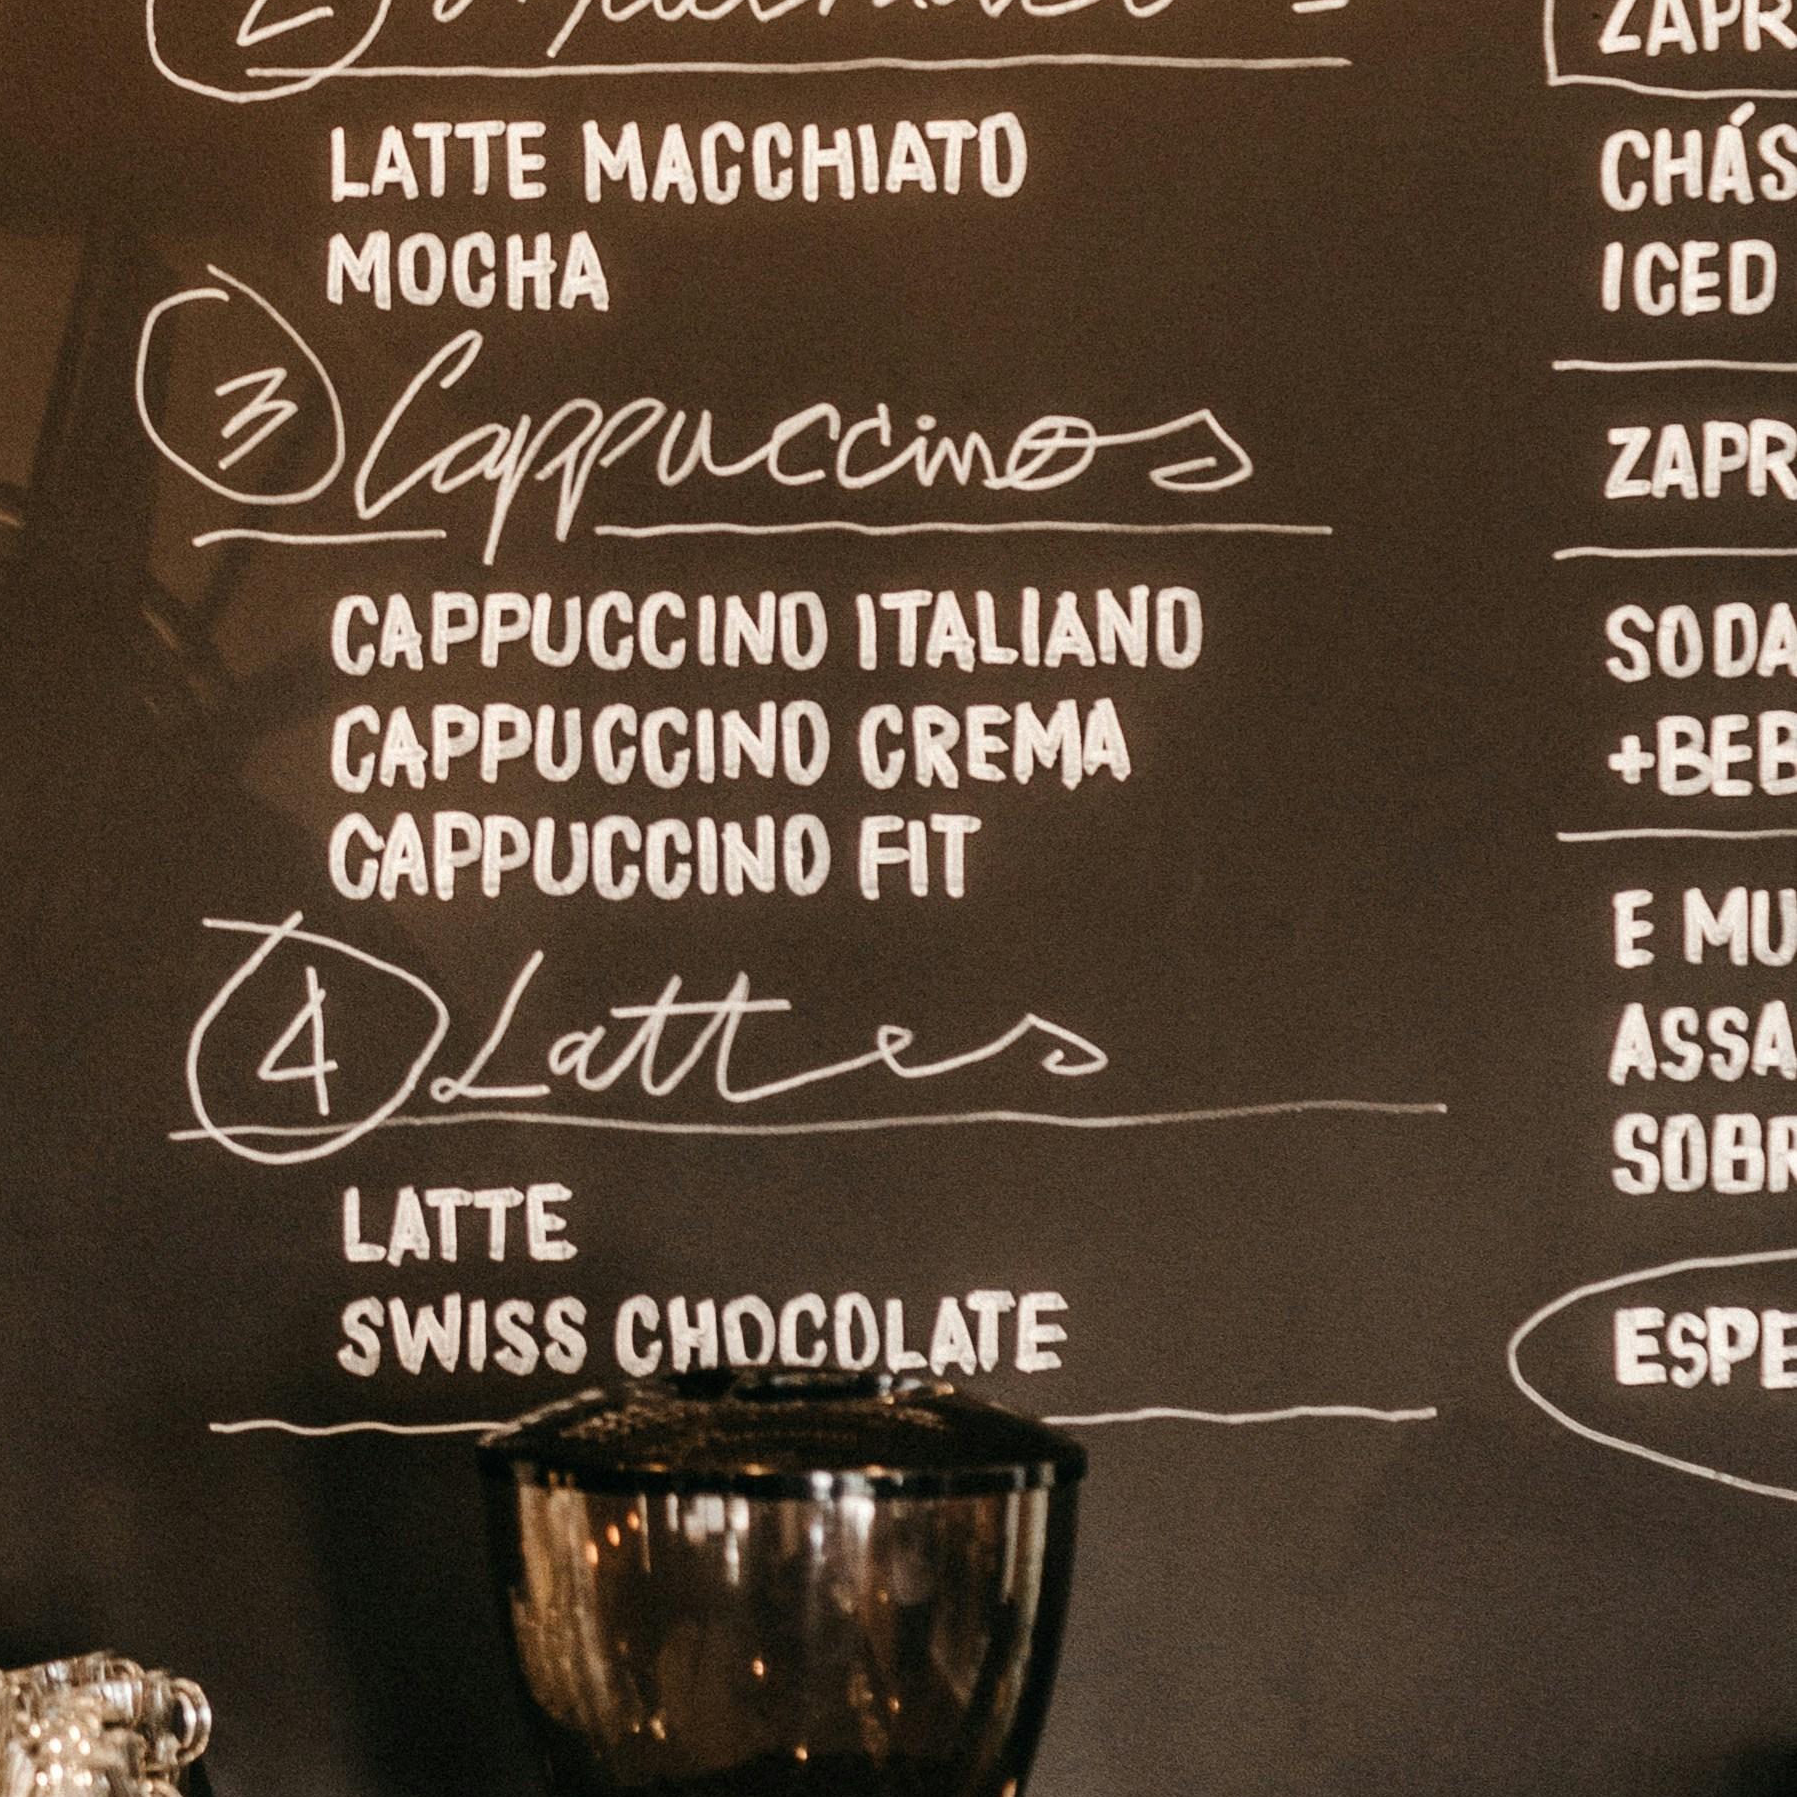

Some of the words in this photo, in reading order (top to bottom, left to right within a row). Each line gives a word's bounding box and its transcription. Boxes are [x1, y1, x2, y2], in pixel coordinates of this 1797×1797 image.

[331, 120, 546, 202] LATTE
[582, 111, 1028, 205] MACCHIATO
[1600, 101, 1797, 211] CHÁS
[327, 230, 609, 312] MOCHA
[1602, 239, 1777, 316] ICED
[215, 367, 298, 470] 3
[355, 329, 1253, 566] Cappuccinos
[1605, 418, 1797, 500] ZAPR
[331, 590, 828, 676] CAPPUCCINO
[856, 584, 1203, 673] ITALIANO
[331, 700, 830, 793] CAPPUCCINO
[858, 697, 1131, 790] CREMA
[329, 810, 831, 901] CAPPUCCINO
[858, 813, 982, 901] FIT
[1613, 889, 1654, 969] E
[257, 968, 338, 1116] 4
[431, 950, 1108, 1101] Lattes
[343, 1182, 578, 1266] LATTE
[337, 1293, 587, 1376] SWISS
[615, 1289, 1069, 1377] CHOCOLATE
